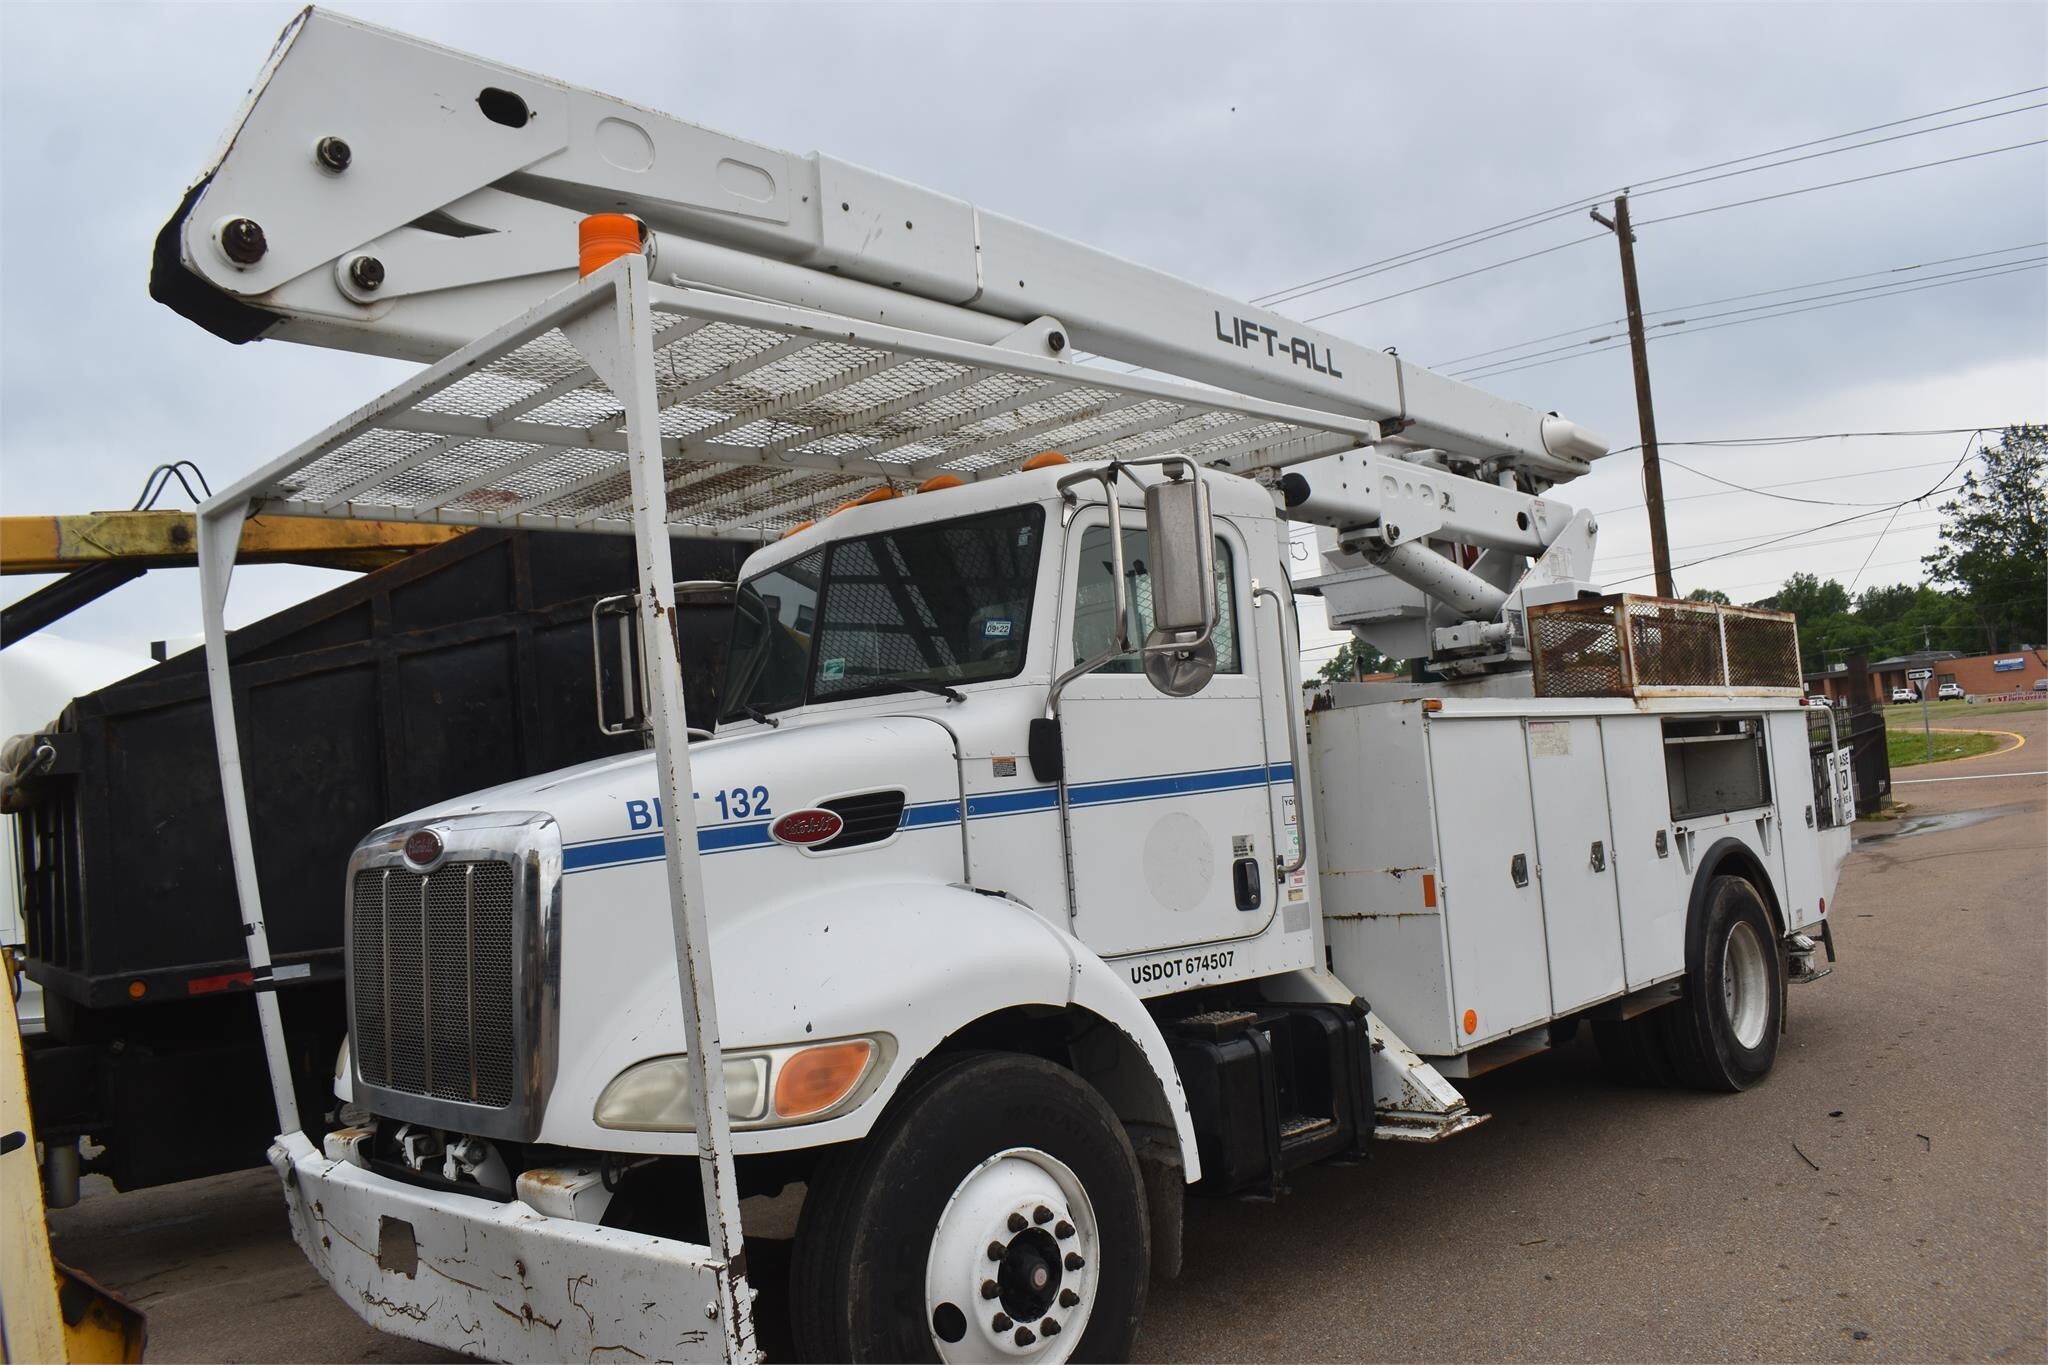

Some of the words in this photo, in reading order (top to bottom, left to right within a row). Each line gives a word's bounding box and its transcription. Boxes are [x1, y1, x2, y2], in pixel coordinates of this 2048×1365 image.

[1214, 310, 1343, 379] LIFT-ALL
[715, 785, 772, 820] 132
[783, 816, 836, 836] Peterbilt
[1131, 959, 1183, 984] USDOT
[1185, 951, 1235, 974] 674507
